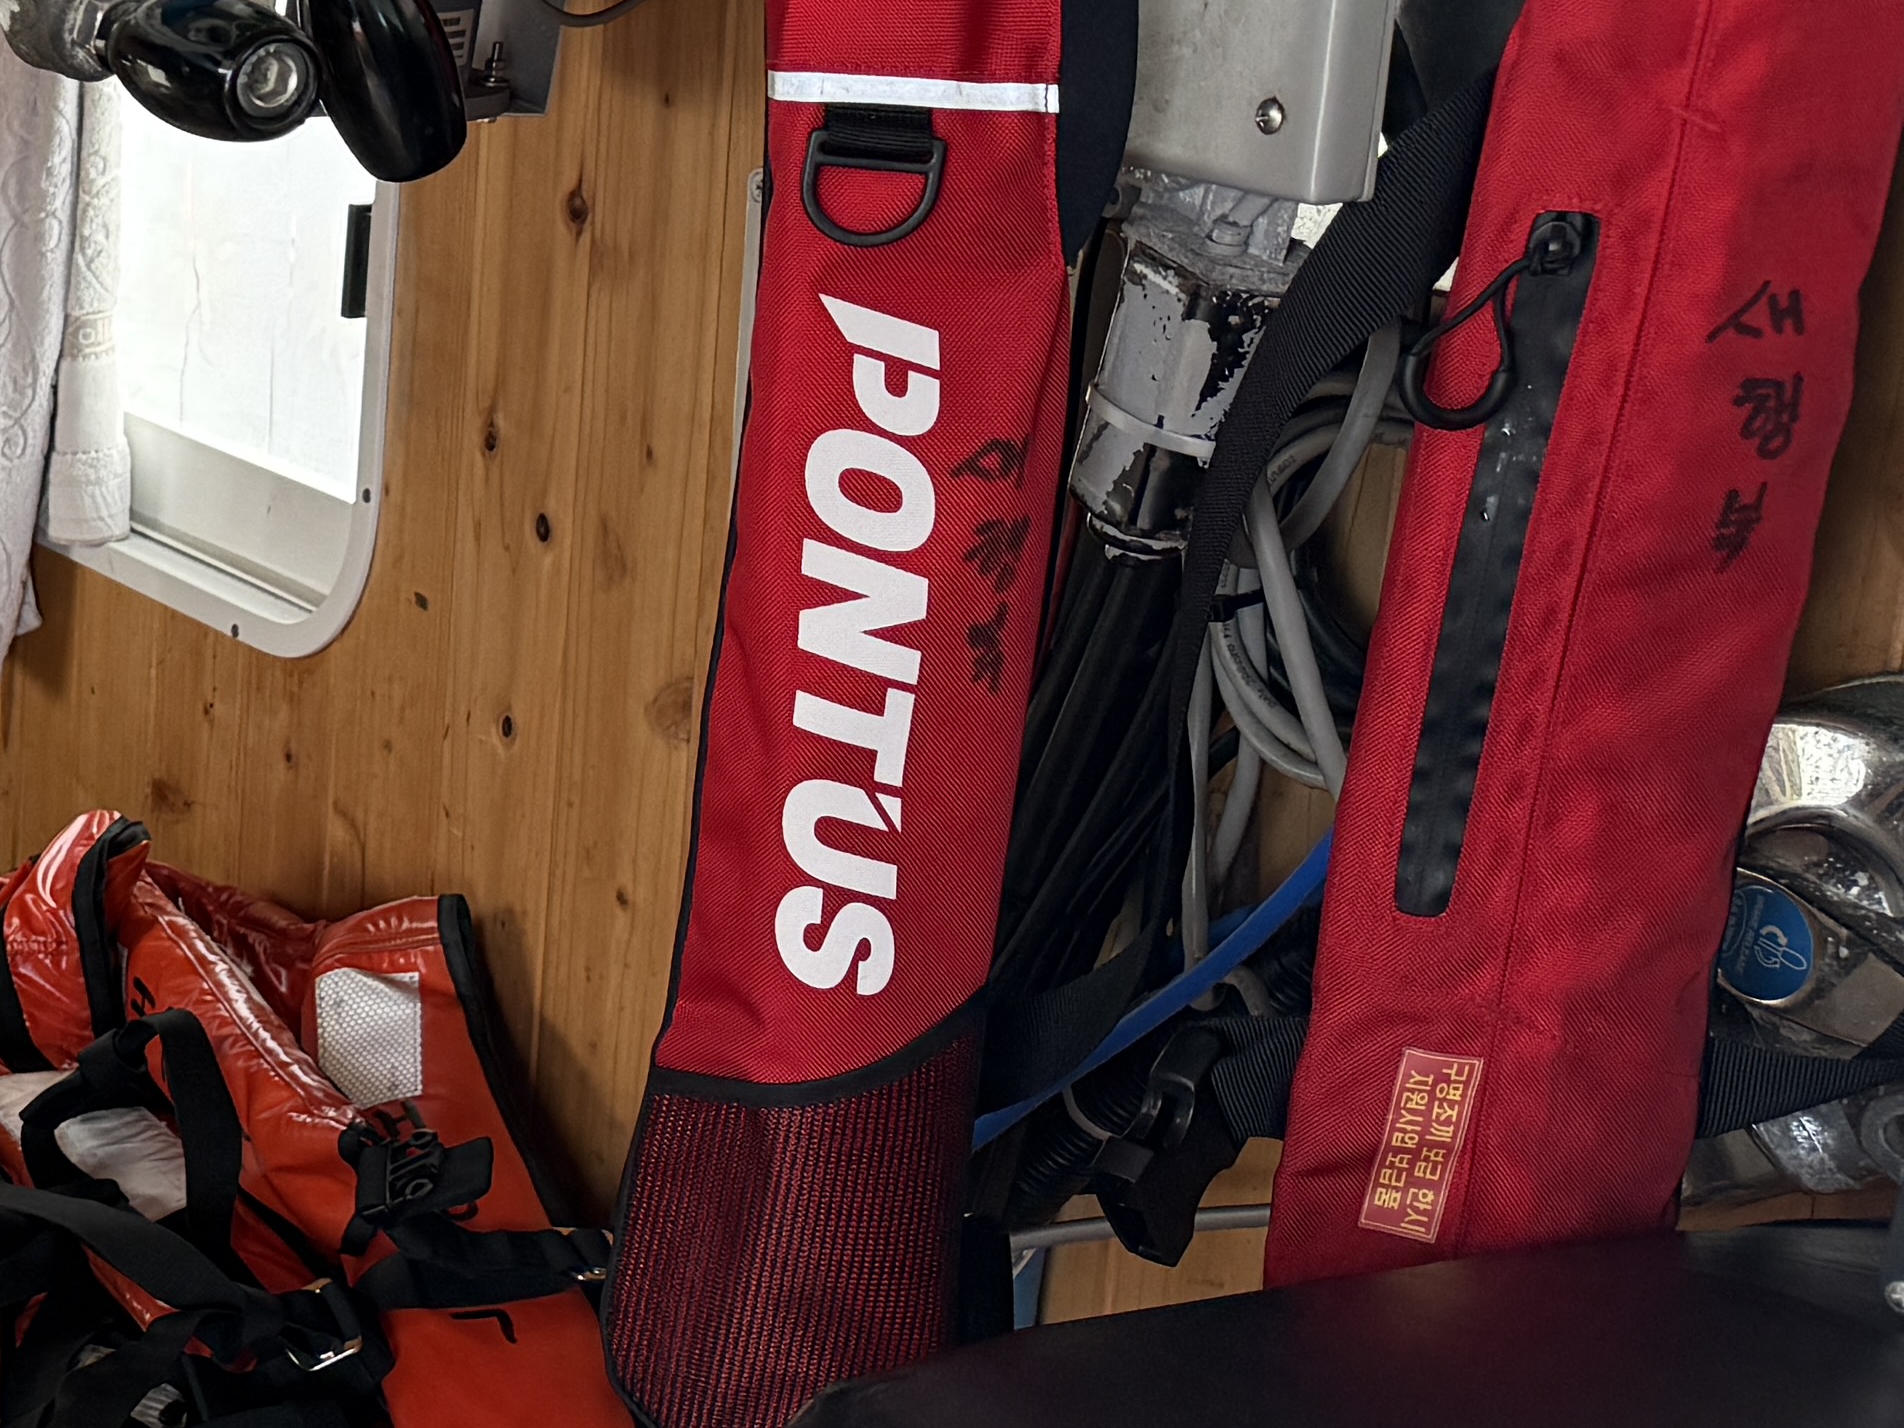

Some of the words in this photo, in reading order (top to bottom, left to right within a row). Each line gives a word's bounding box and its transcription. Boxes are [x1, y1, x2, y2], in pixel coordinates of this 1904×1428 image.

[774, 292, 941, 998] PONTUS
[1391, 1069, 1434, 1148] 지원사업
[1425, 1062, 1470, 1142] 구명조끼
[1374, 1152, 1412, 1210] 보급품
[1414, 1147, 1447, 1181] 보급
[1400, 1187, 1435, 1232] 한시
